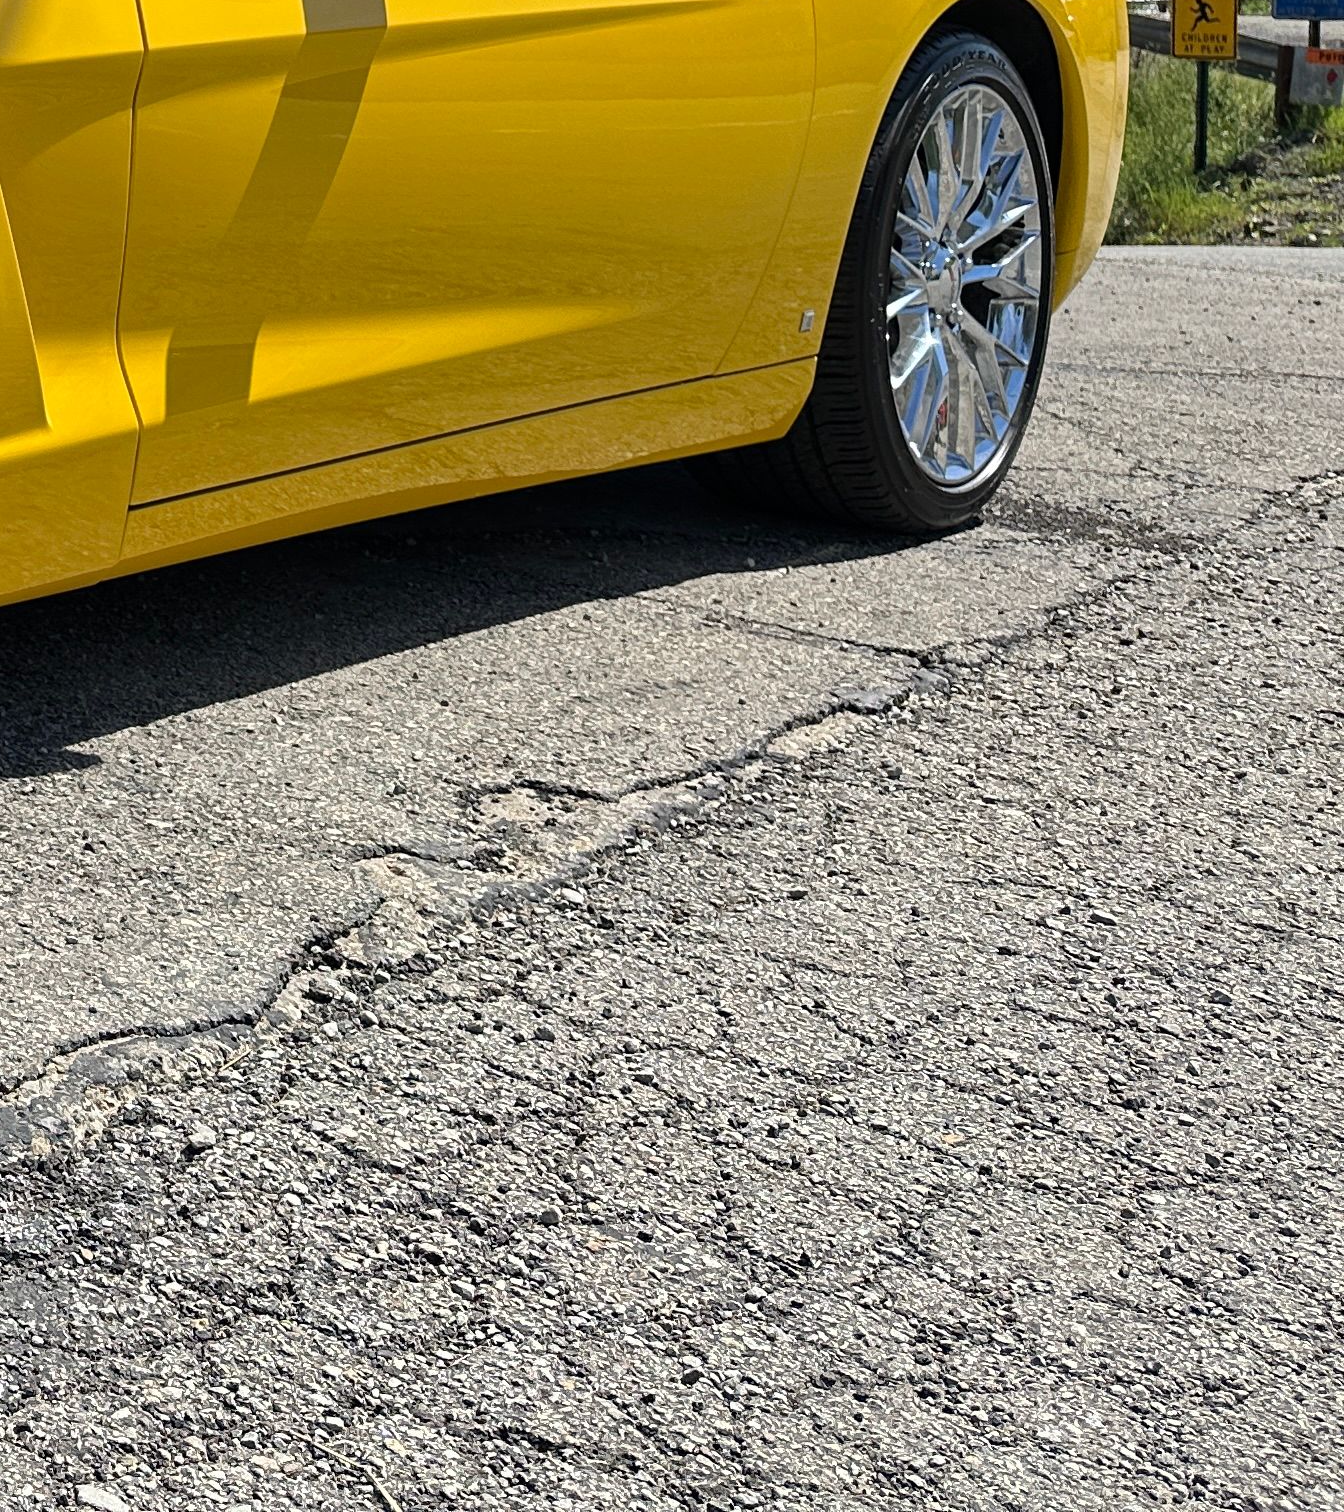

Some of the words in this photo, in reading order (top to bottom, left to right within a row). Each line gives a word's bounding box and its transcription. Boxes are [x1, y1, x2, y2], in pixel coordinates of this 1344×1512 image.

[1181, 31, 1228, 43] CHILDREN
[1184, 43, 1194, 54] AT
[1200, 44, 1225, 55] PLAY
